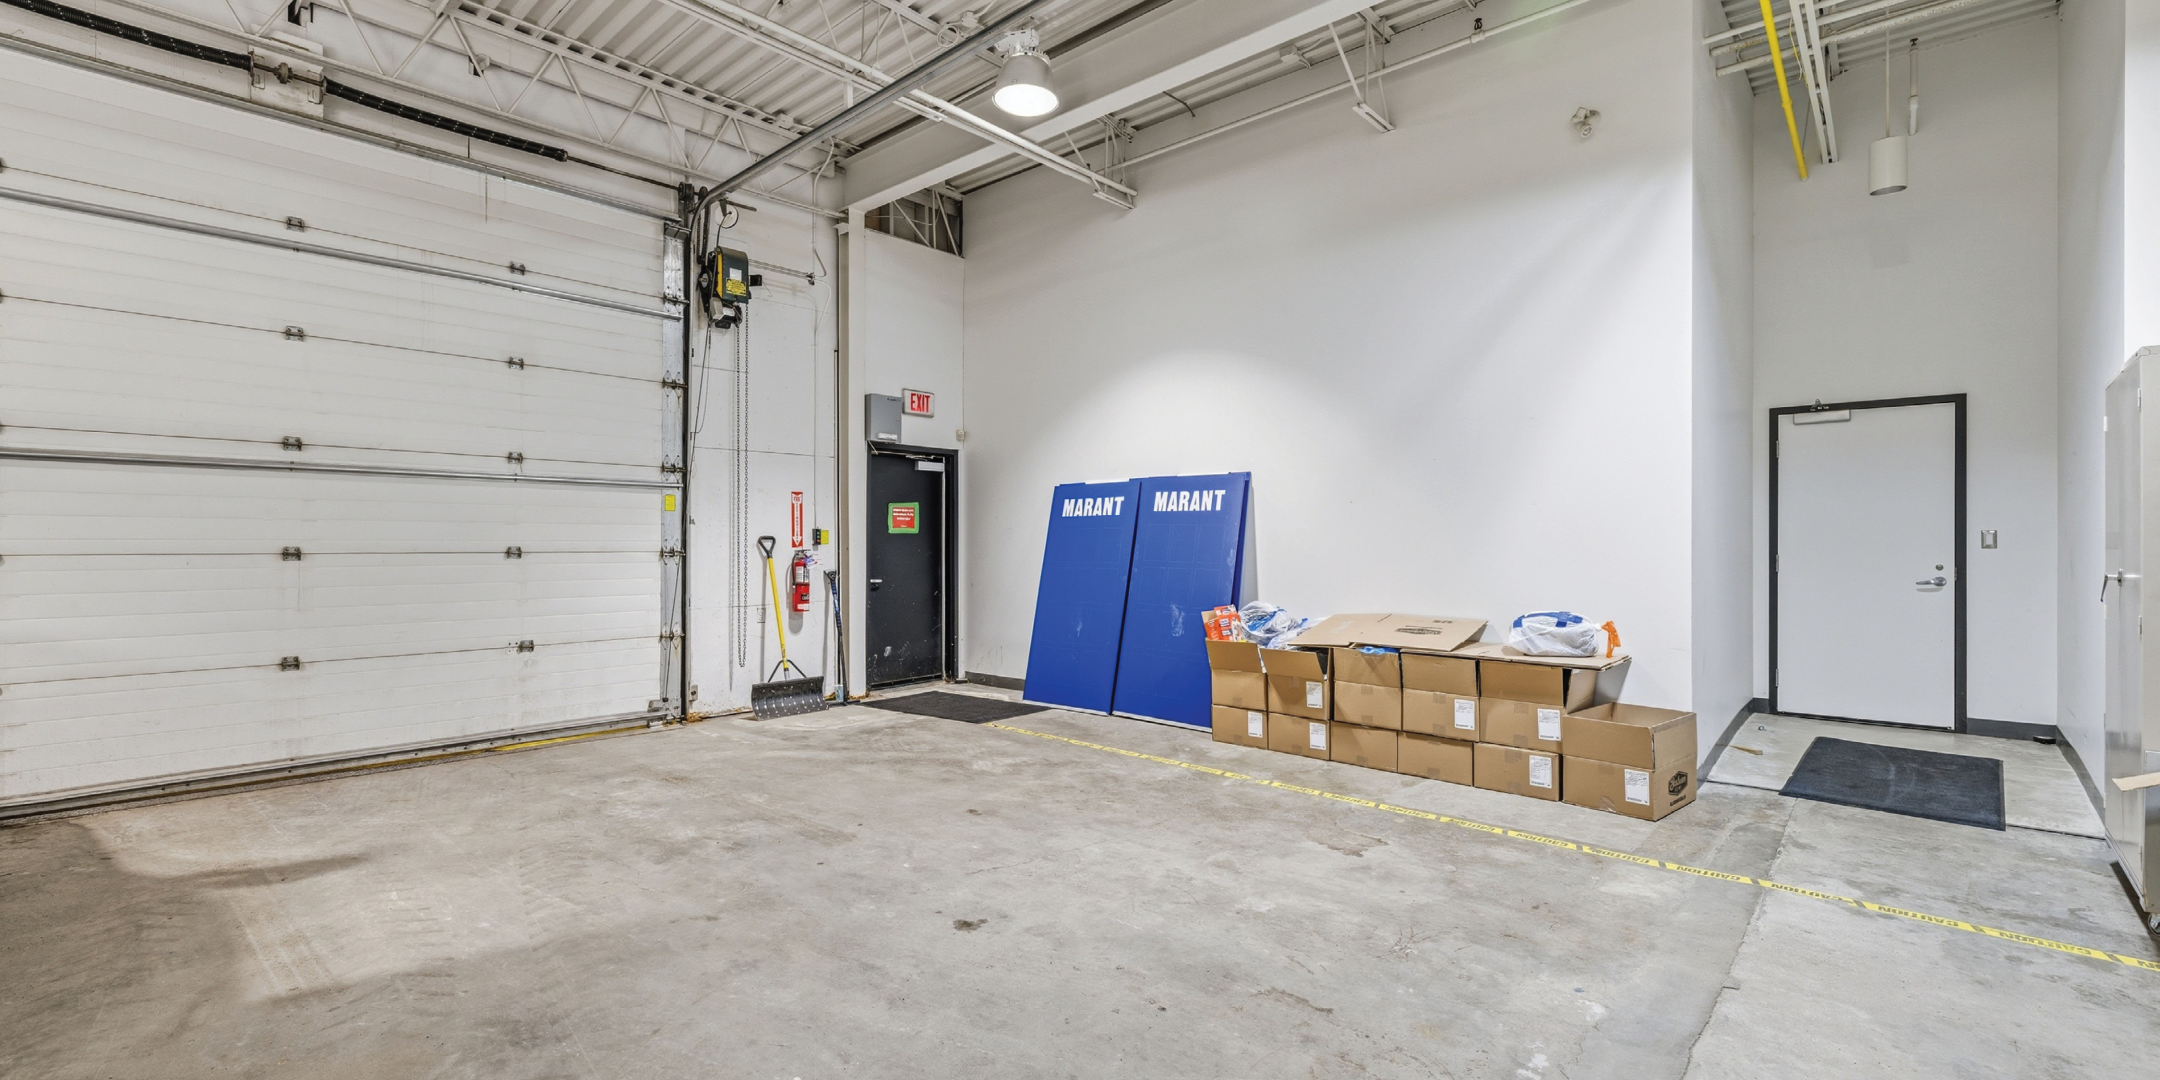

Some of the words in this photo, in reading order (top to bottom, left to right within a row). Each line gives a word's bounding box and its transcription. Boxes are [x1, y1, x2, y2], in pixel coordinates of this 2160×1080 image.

[910, 392, 931, 413] EXIT
[1062, 496, 1125, 517] MARANT
[1153, 489, 1226, 512] MARANT
[1386, 805, 1429, 817] CAUTION
[1449, 818, 1495, 831] CAUTION
[1516, 832, 1568, 847] CAUTION
[1592, 848, 1650, 864] CAUTION
[1676, 865, 1741, 881] CAUTION
[1771, 883, 1843, 902] CAUTION
[1878, 905, 1959, 927] CAUTION
[1999, 932, 2092, 955] CAUTION
